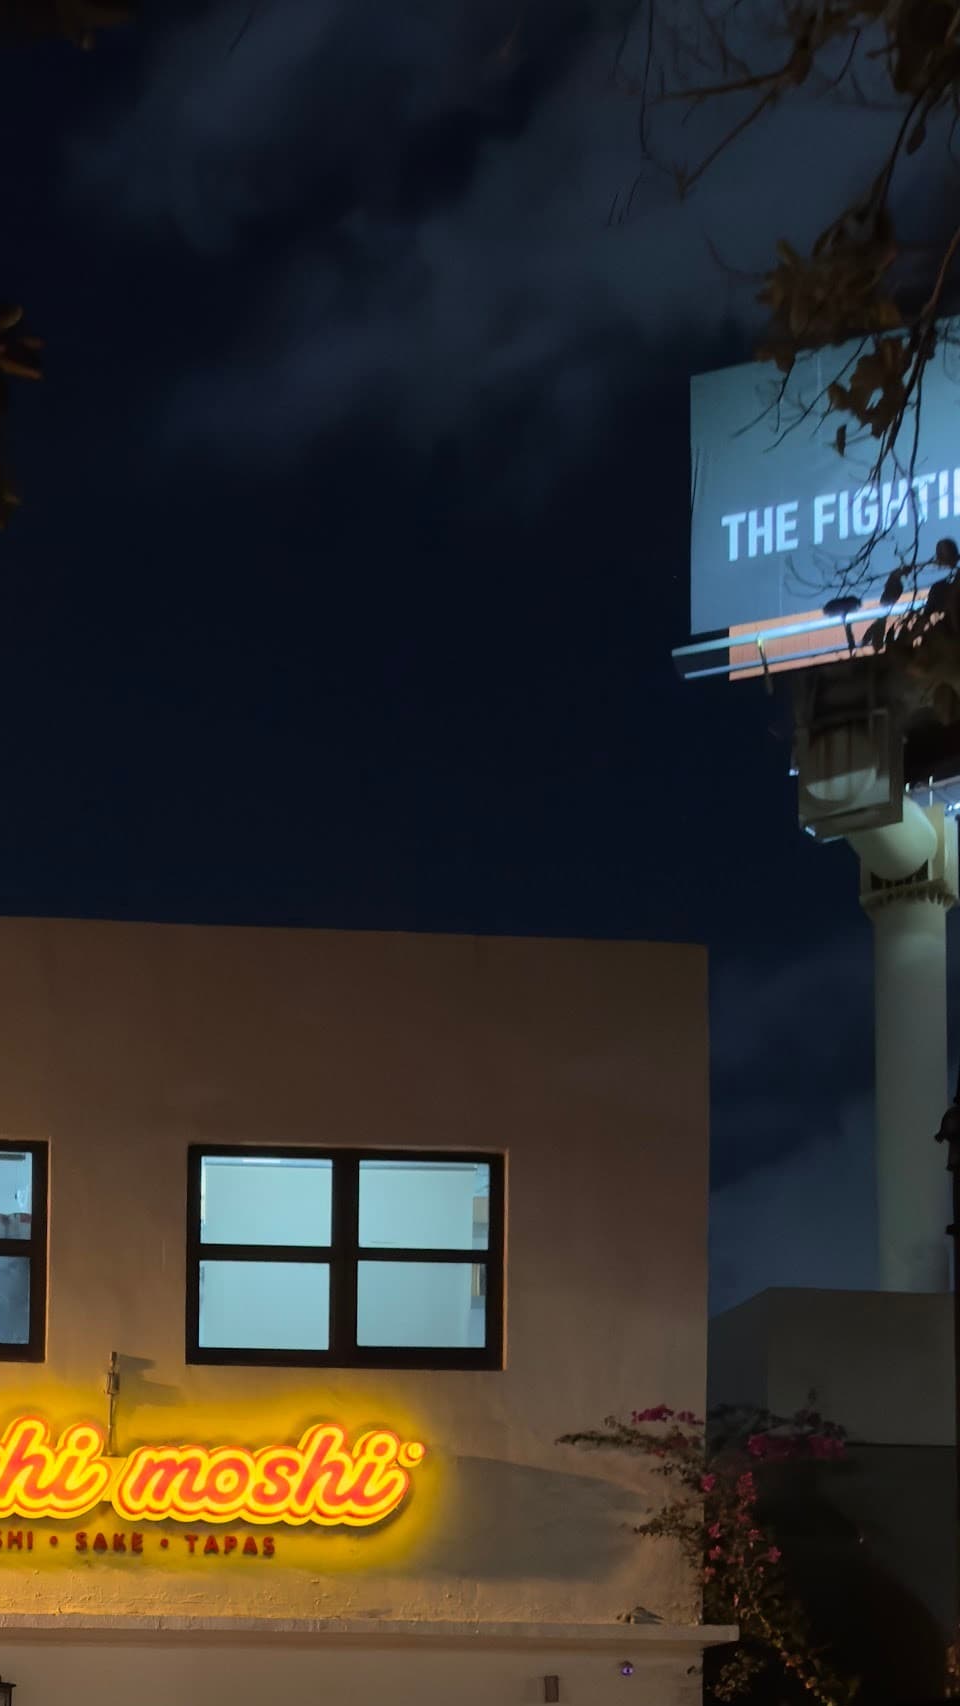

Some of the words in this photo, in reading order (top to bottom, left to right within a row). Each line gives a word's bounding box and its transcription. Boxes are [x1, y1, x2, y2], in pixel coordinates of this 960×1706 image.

[721, 501, 799, 562] THE
[813, 467, 960, 546] FIGHTI
[114, 1425, 410, 1524] moshi
[75, 1532, 144, 1554] SAKE
[185, 1534, 277, 1556] TAPAS
